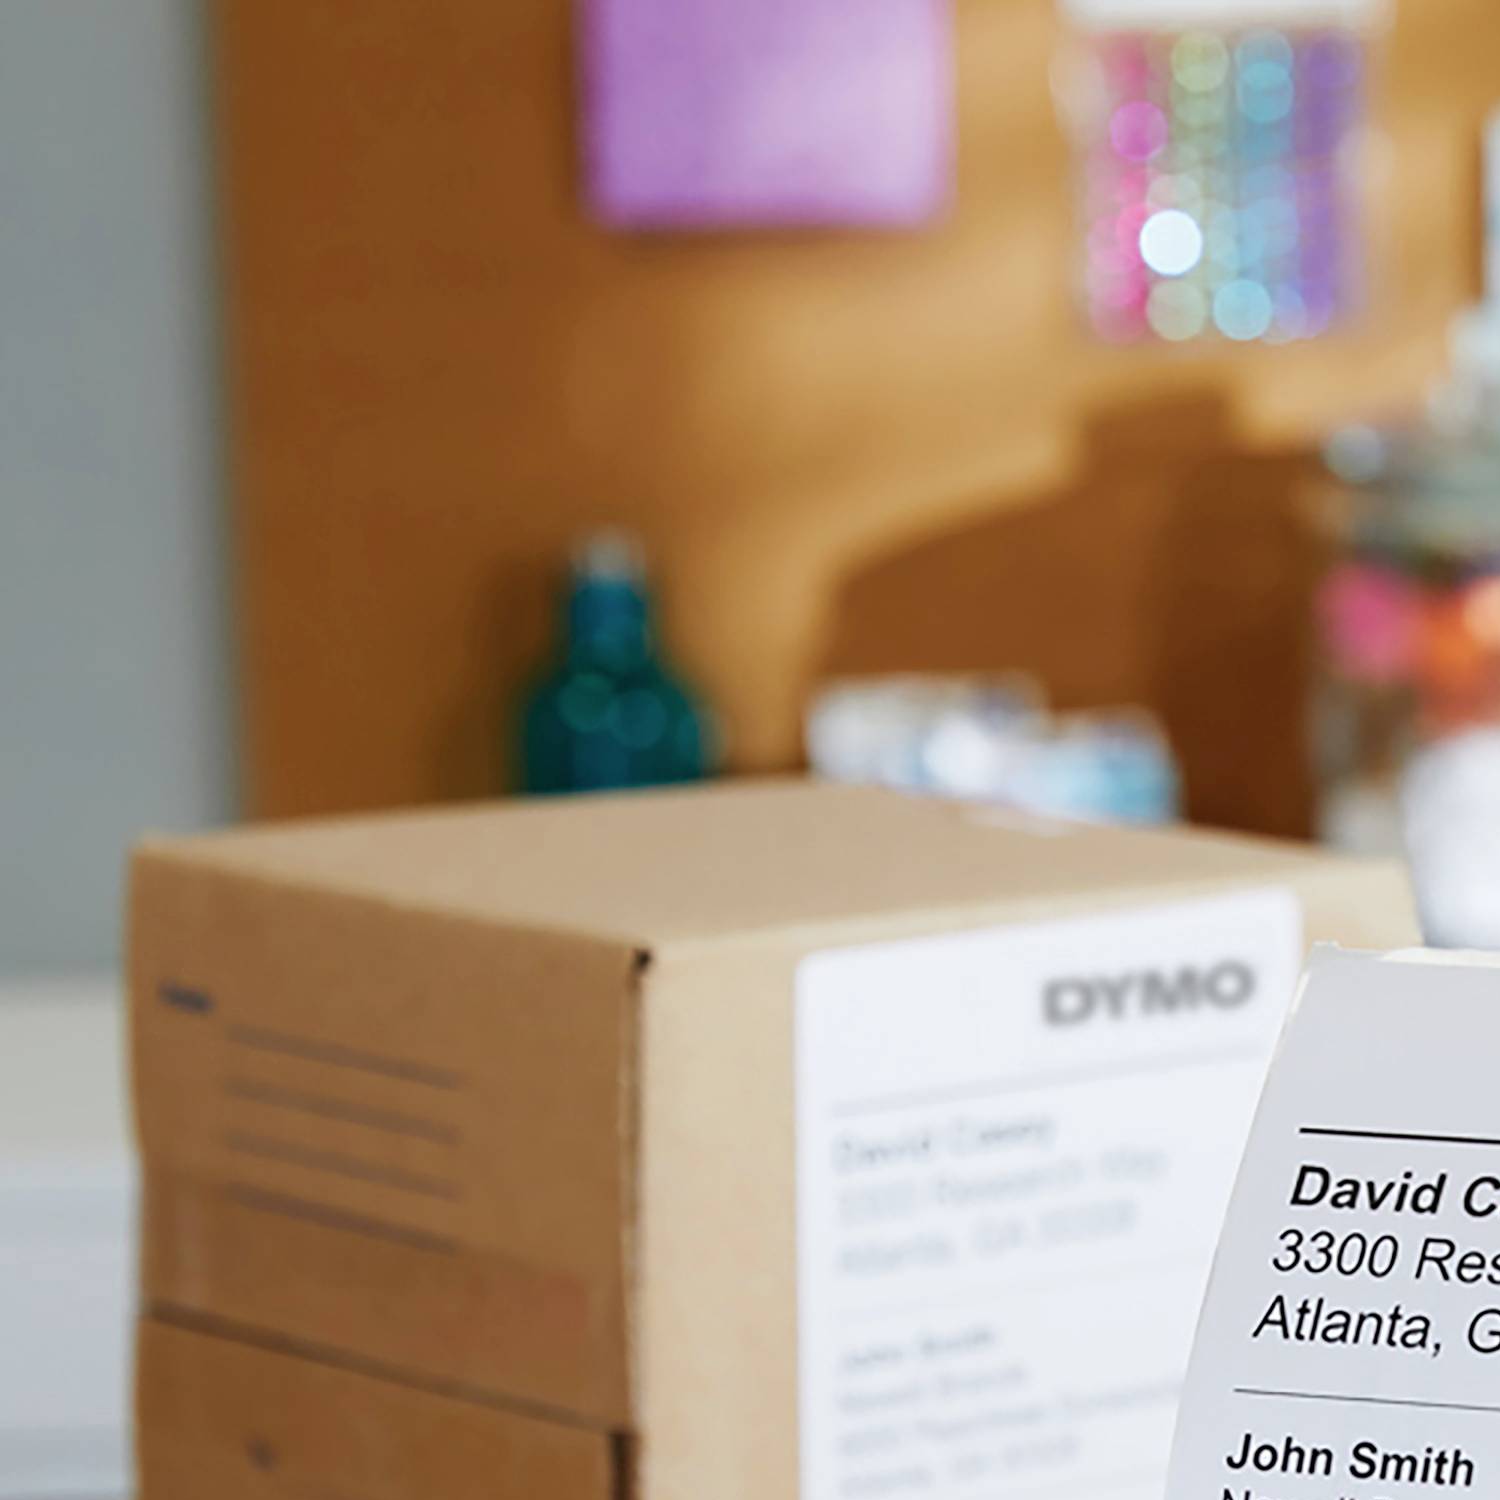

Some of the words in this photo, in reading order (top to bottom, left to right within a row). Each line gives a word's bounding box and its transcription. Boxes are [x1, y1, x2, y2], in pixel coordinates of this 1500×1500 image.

[1044, 962, 1255, 1025] DYMO
[1290, 1165, 1447, 1214] David
[1273, 1229, 1399, 1278] 3300
[1252, 1295, 1441, 1357] Atlanta,
[1226, 1433, 1333, 1476] John
[1349, 1441, 1474, 1487] Smith
